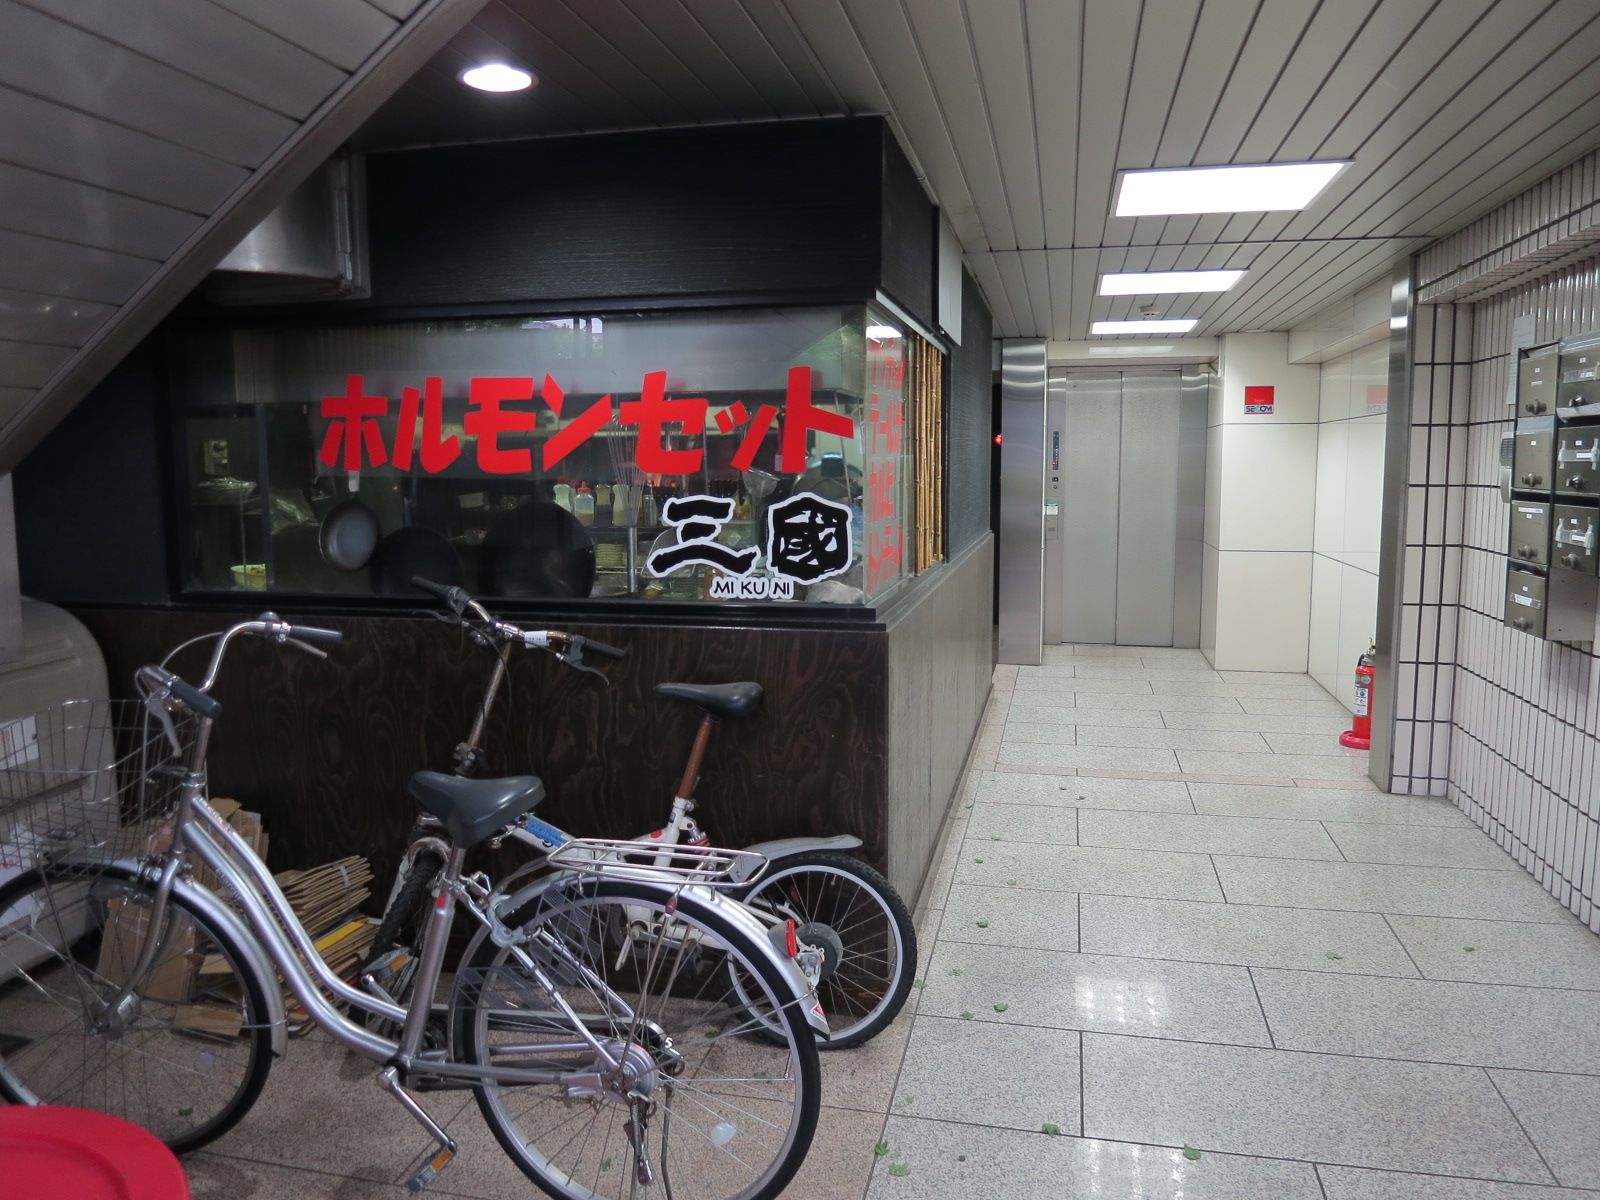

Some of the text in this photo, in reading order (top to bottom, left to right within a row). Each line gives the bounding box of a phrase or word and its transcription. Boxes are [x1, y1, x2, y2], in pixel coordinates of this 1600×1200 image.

[319, 365, 854, 475] ホルモンセット
[1245, 405, 1272, 413] SECOM
